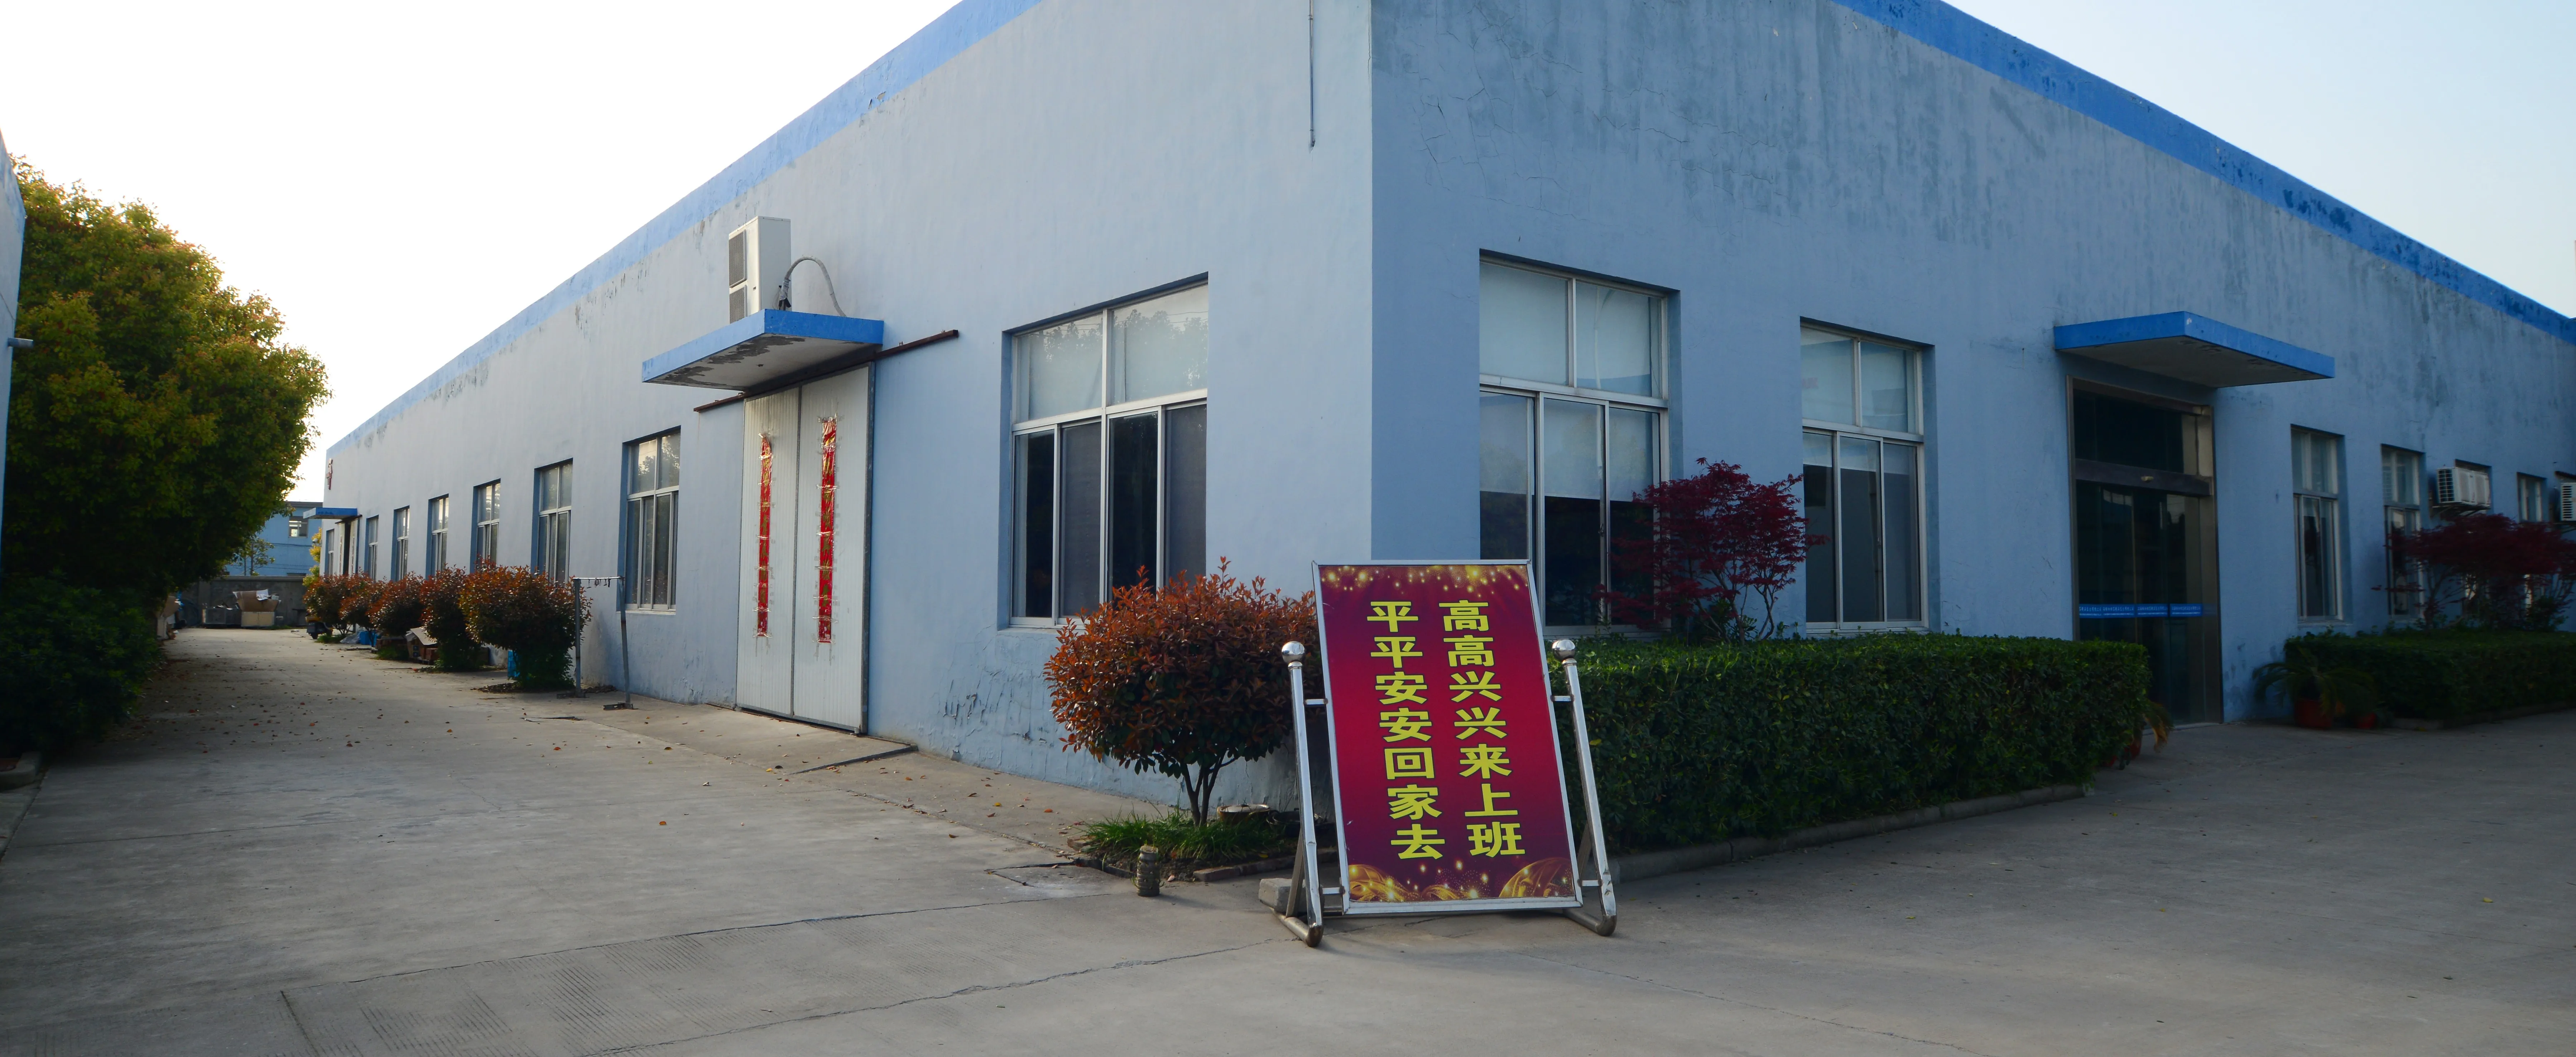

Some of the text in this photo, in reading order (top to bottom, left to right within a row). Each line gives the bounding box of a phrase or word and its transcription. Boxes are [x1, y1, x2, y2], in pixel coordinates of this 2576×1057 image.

[1367, 601, 1445, 859] 平平安安回家去
[1439, 599, 1525, 858] 高高兴兴来上班
